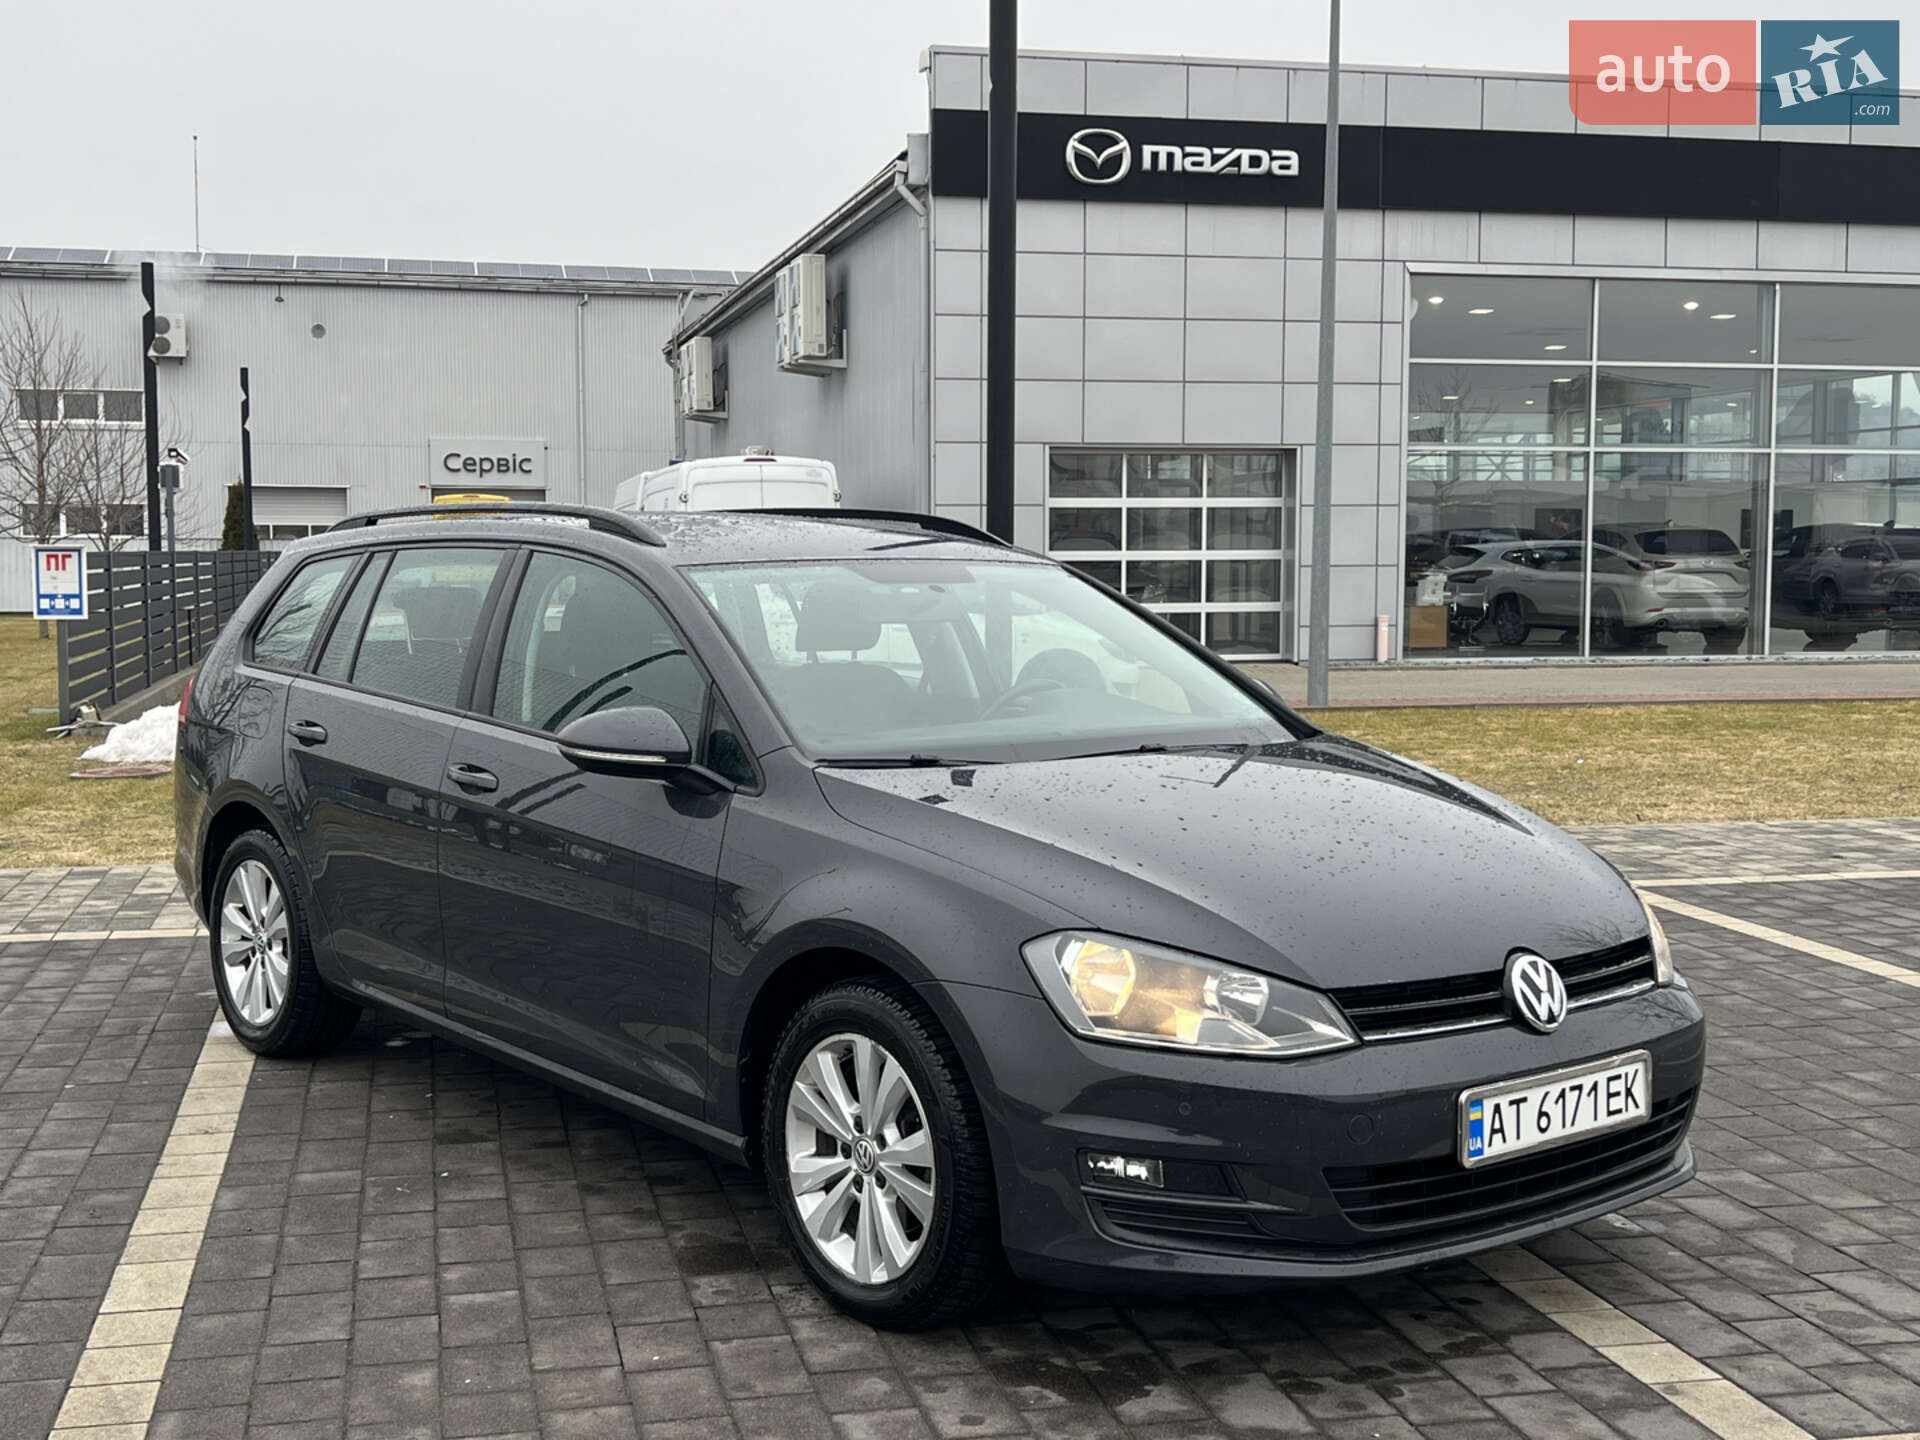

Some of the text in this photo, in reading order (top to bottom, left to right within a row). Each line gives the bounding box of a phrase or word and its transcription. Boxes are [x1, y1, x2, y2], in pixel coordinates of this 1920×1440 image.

[1142, 144, 1300, 176] mazda
[443, 452, 532, 478] Сервіс
[46, 554, 72, 571] ПГ
[1488, 1097, 1528, 1147] AT
[1469, 1137, 1482, 1151] UA
